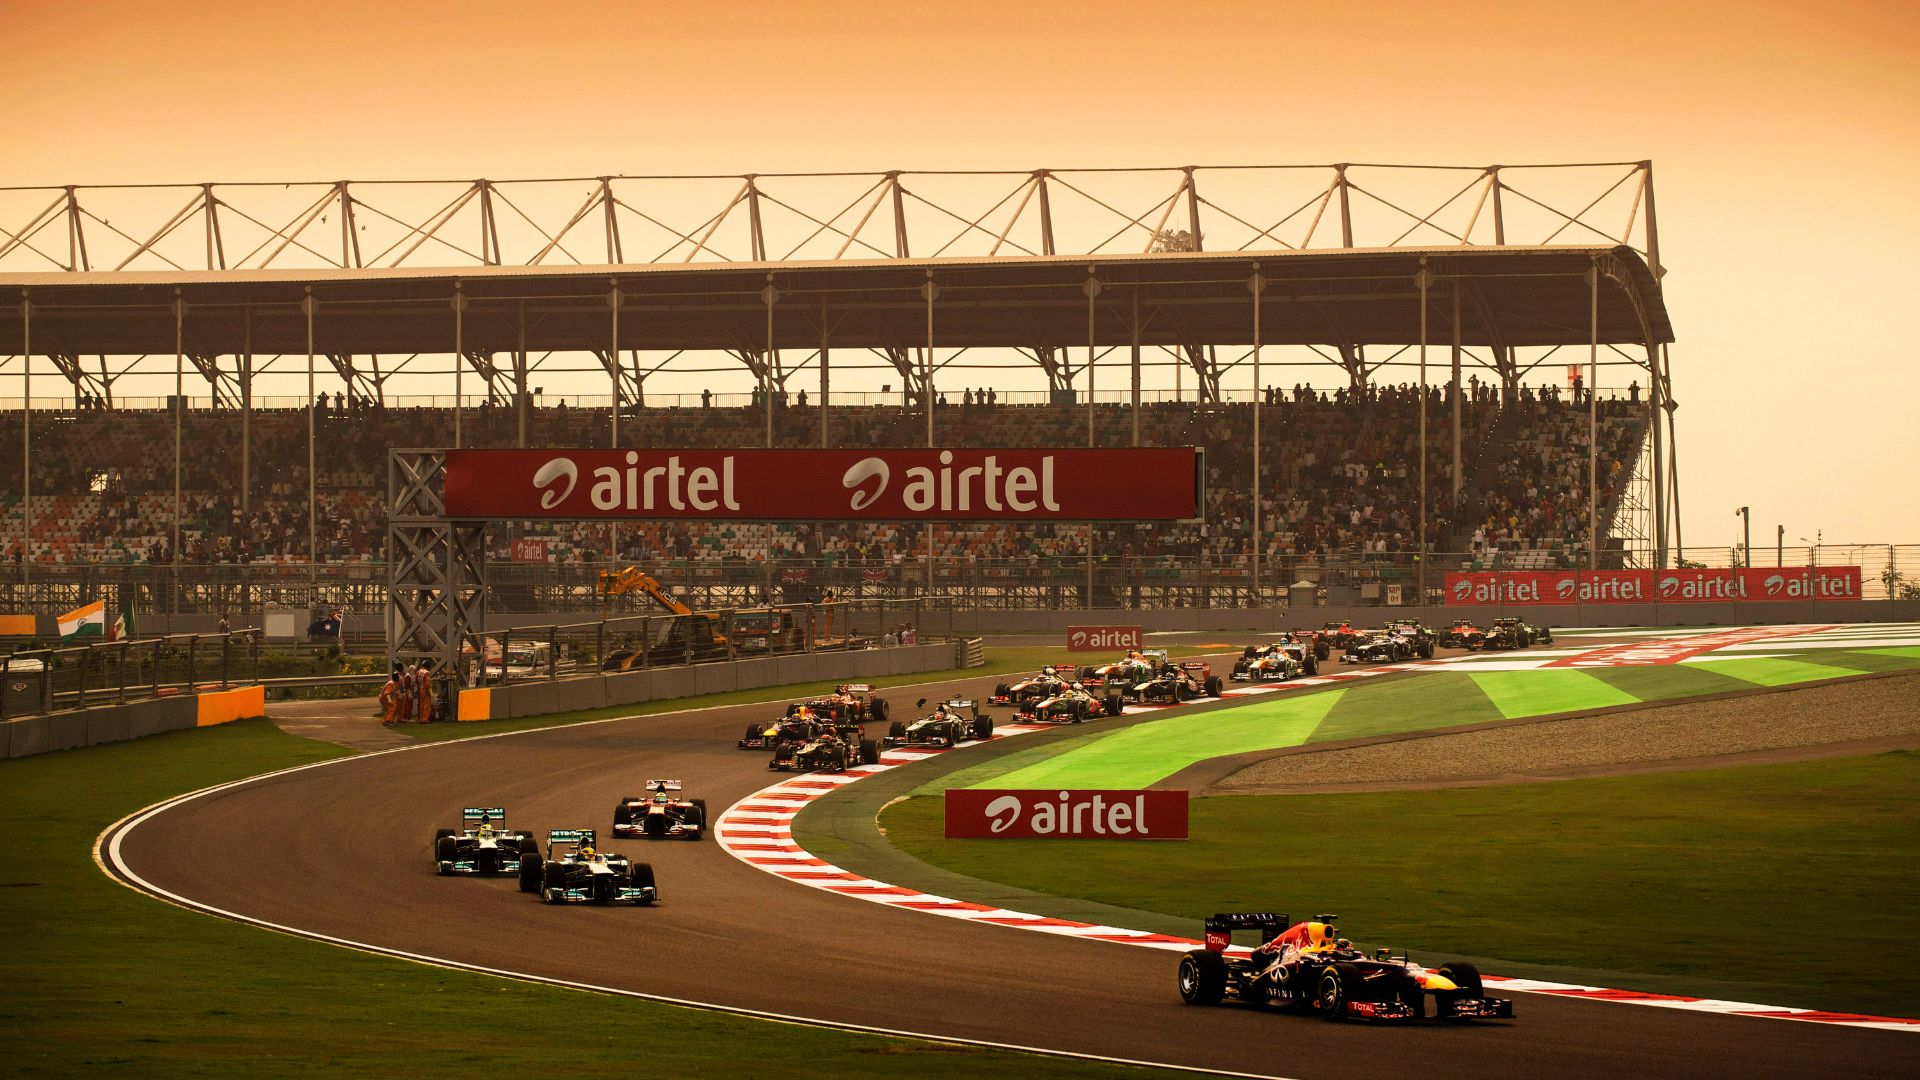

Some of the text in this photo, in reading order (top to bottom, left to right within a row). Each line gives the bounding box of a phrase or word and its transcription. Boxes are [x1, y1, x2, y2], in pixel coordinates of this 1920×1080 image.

[591, 450, 1060, 511] airtel airtel
[524, 540, 542, 560] airtel
[1476, 576, 1643, 601] airtel airtel
[1682, 572, 1853, 598] airtel airtel
[660, 589, 677, 605] JCB
[1090, 629, 1138, 647] airtel
[1031, 791, 1149, 834] airtel
[1206, 933, 1227, 945] TOTAL
[1351, 1001, 1375, 1013] TOTAL
